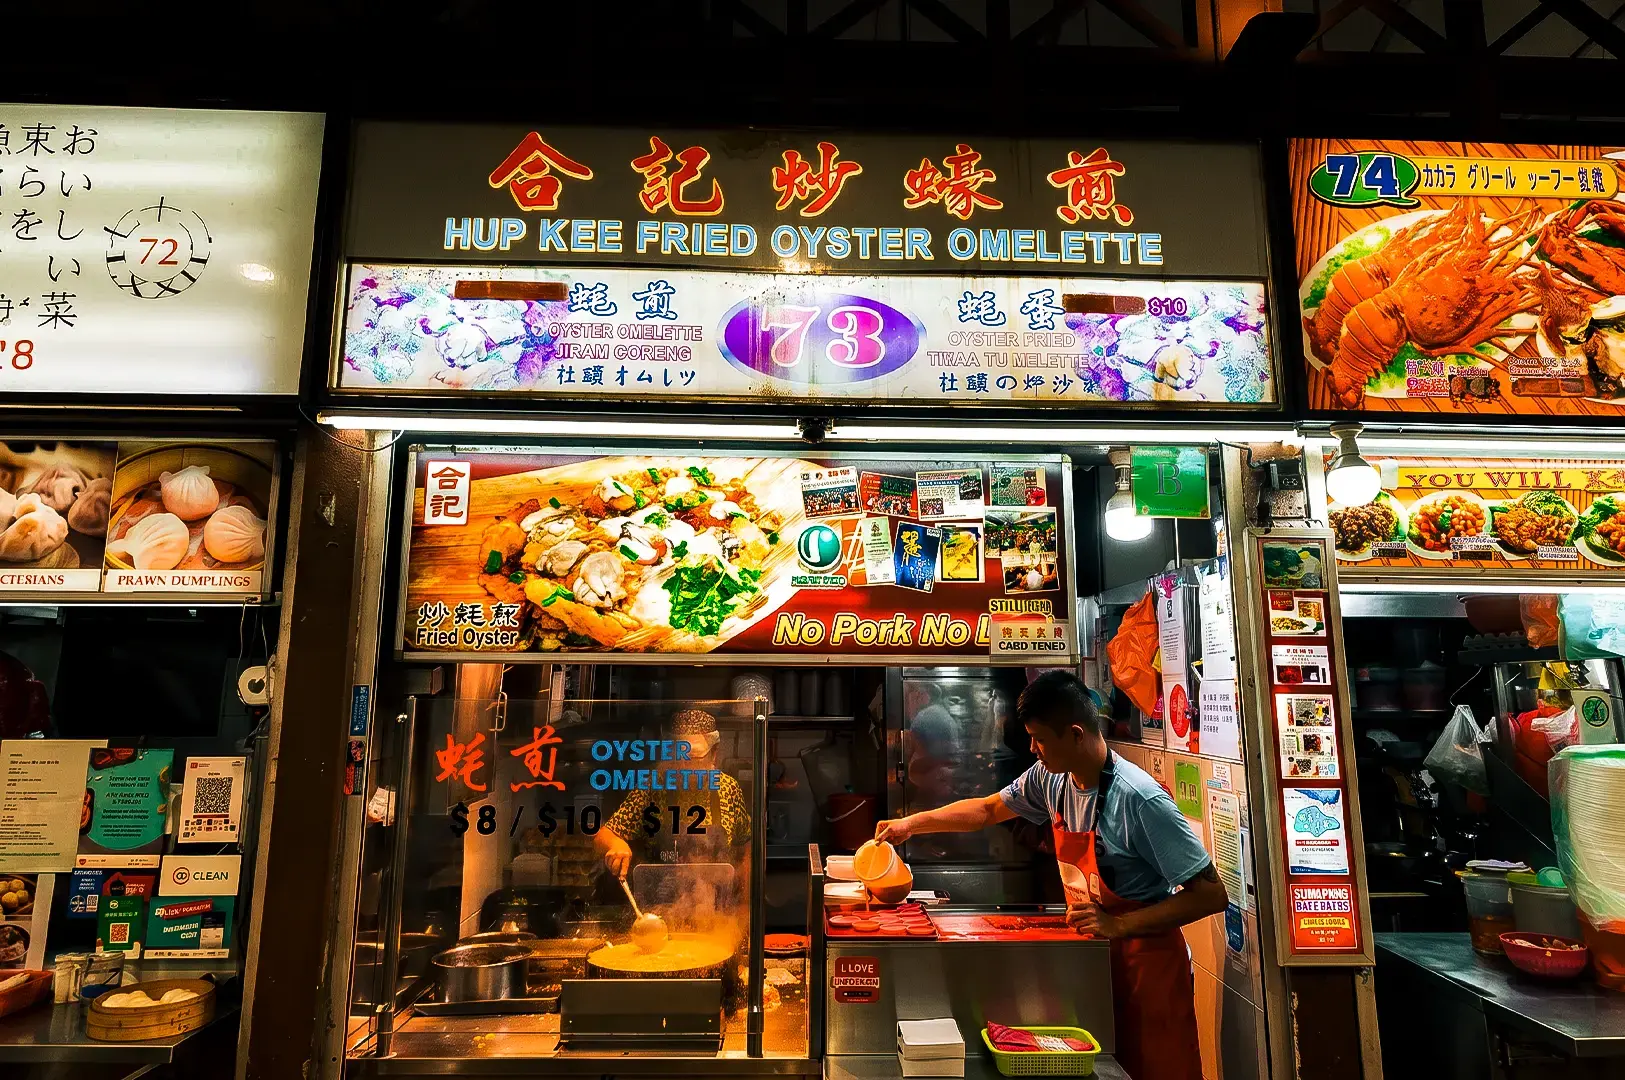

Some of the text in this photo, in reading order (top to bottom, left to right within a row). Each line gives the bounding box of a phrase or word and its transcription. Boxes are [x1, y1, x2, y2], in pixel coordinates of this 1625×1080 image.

[1325, 153, 1400, 198] 74
[444, 217, 1164, 265] HUP KEE FRIED OYSTER OMELETTE
[139, 239, 179, 266] 72
[547, 322, 703, 342] OYSTER OMELETTE
[761, 304, 886, 369] 73
[948, 331, 1019, 347] OYSTER
[1154, 461, 1183, 496] B
[1405, 473, 1476, 488] YOU
[1484, 471, 1572, 489] WILL
[429, 466, 466, 518] 合記
[118, 575, 251, 587] PRAWN DUMPLINGS
[416, 627, 518, 649] Fried Oyster
[772, 612, 824, 646] No
[830, 612, 916, 646] Pork
[918, 613, 970, 646] No
[591, 740, 692, 762] OYSTER
[589, 769, 721, 791] OMELETTE
[450, 801, 498, 838] $8
[538, 802, 602, 837] $10
[642, 802, 708, 838] $12
[192, 871, 229, 881] CLEAN
[848, 963, 874, 973] LOVE
